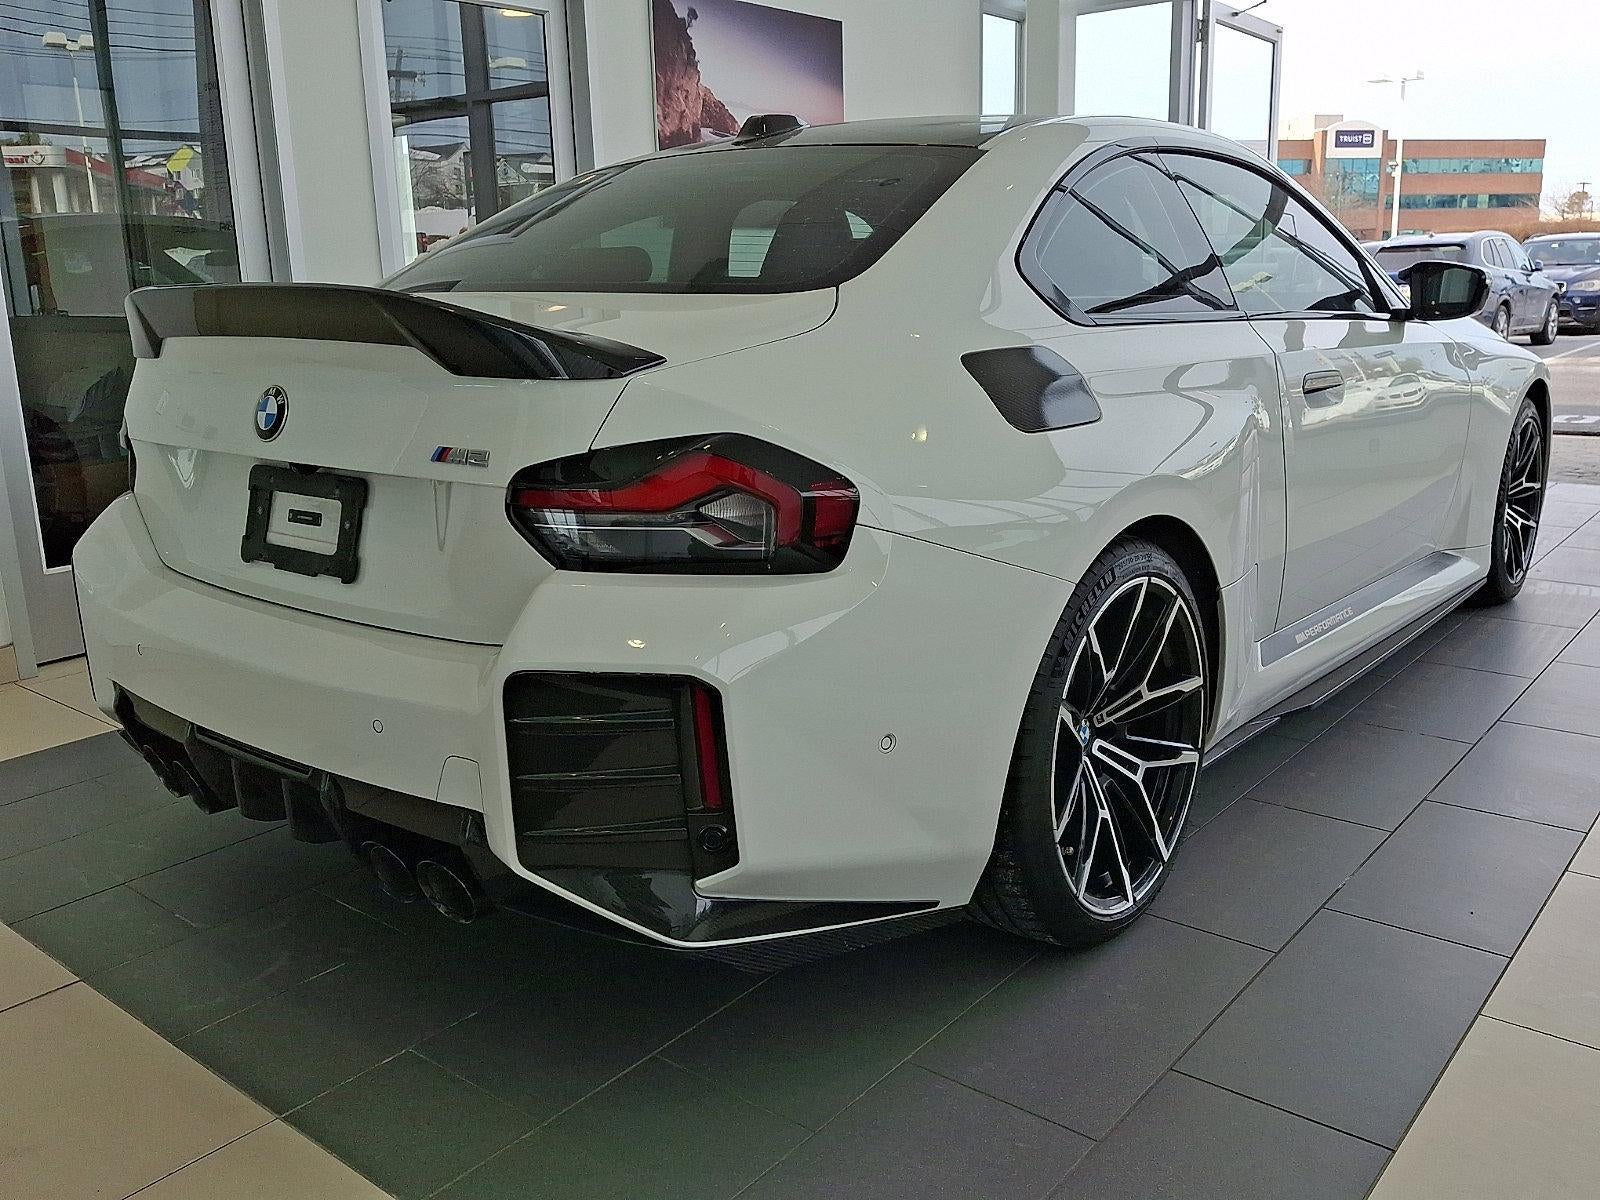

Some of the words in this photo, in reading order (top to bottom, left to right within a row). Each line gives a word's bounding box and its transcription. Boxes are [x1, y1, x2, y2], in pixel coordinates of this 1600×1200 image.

[1339, 134, 1363, 143] TRUIST
[447, 446, 491, 468] M2
[1062, 570, 1114, 652] MICHELIN
[1304, 606, 1354, 639] PERFORMANCE
